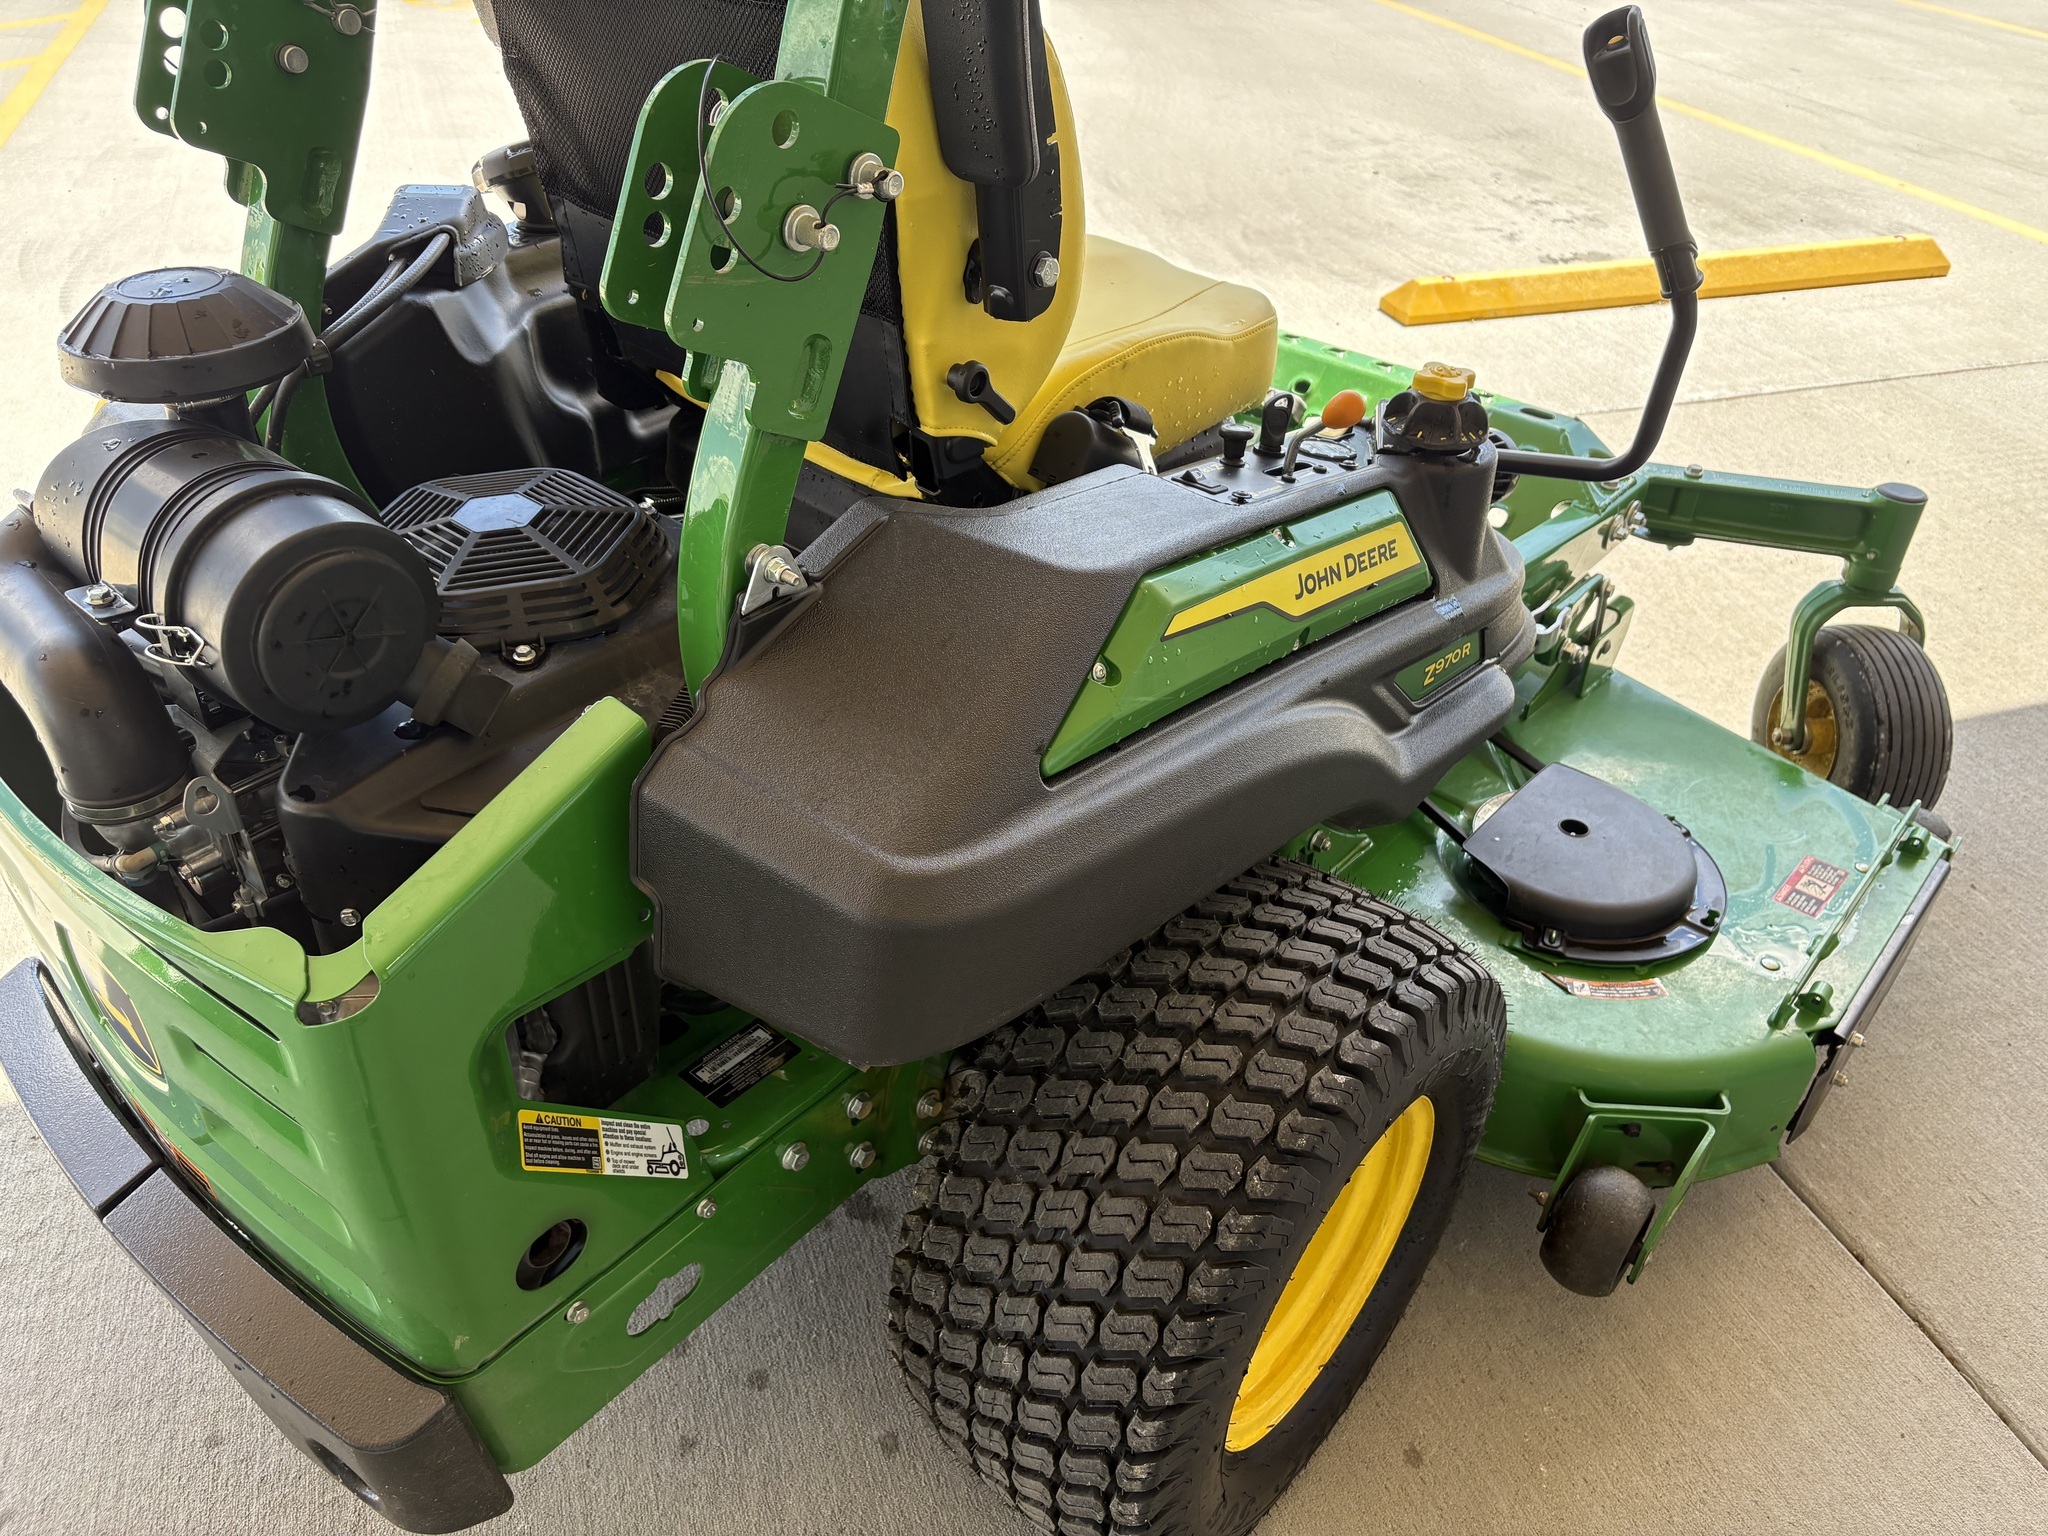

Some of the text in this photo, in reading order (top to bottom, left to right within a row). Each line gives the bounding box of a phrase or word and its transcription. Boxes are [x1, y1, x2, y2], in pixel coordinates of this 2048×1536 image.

[1295, 538, 1398, 600] JOHN DEERE
[1423, 642, 1471, 687] Z970R
[544, 1115, 581, 1127] CAUTION
